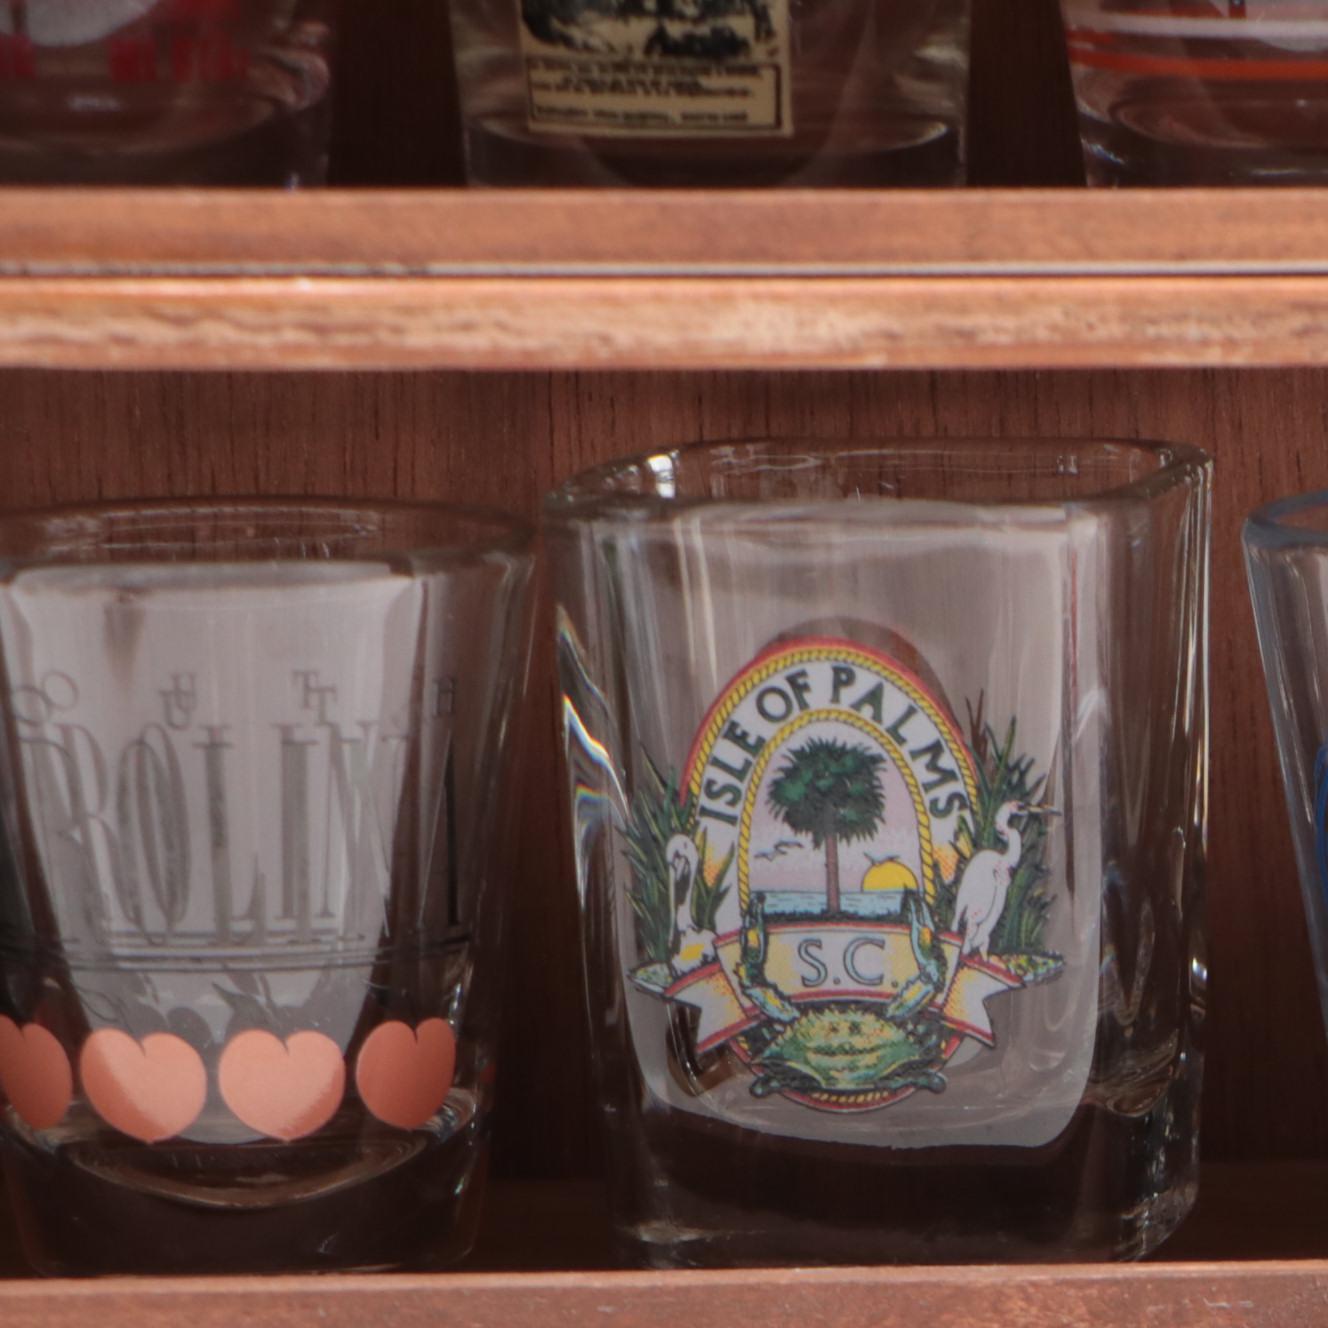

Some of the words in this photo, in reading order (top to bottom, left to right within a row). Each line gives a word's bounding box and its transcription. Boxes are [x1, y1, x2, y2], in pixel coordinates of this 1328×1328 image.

[697, 721, 766, 827] ISLE
[754, 669, 814, 724] OF
[830, 664, 969, 820] PALMS
[793, 935, 902, 990] S.C.
